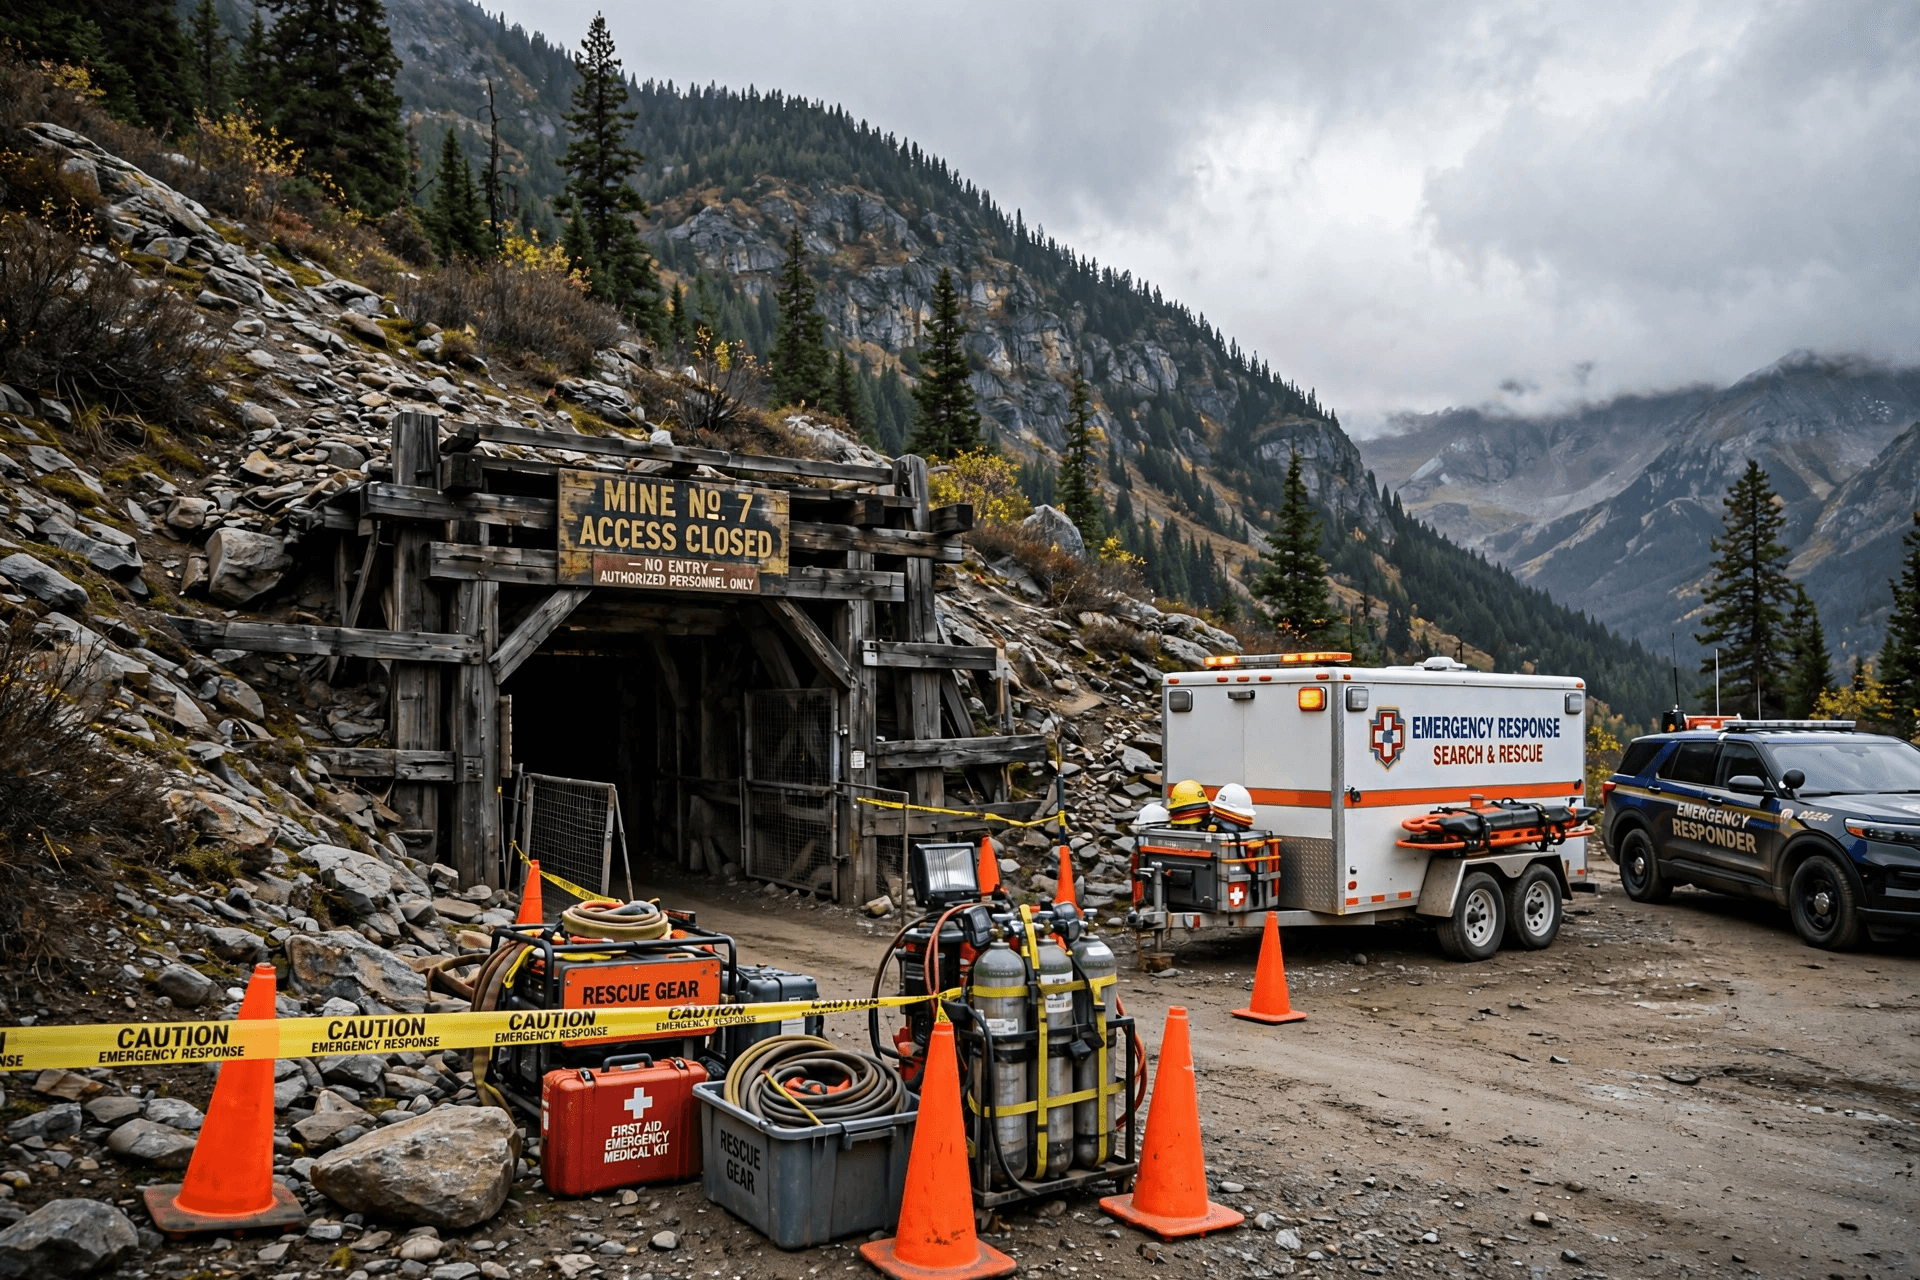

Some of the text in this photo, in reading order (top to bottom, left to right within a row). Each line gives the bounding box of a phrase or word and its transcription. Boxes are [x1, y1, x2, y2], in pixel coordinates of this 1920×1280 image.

[604, 479, 676, 518] MINE
[737, 492, 753, 523] 7
[579, 515, 772, 558] ACCESS CLOSED
[644, 558, 708, 574] NO ENTRY
[600, 570, 754, 591] AUTHORIZED PERSONNEL ONLY
[1412, 716, 1560, 739] EMERGENCY RESPONSE
[1433, 744, 1543, 766] SEARCH & RESCUE
[1676, 801, 1750, 829] EMERGENCY
[1671, 818, 1757, 854] RESPONDER
[582, 980, 699, 1005] RESCUE GEAR
[508, 1010, 596, 1031] CAUTION
[656, 1015, 757, 1031] EMERGENCY RESPONSE
[668, 1005, 745, 1020] CAUTION
[117, 1025, 229, 1049] CAUTION
[328, 1017, 426, 1040] CAUTION
[495, 1026, 608, 1043] EMERGENCY RESPONSE
[98, 1045, 245, 1063] EMERGENCY RESPONSE
[311, 1036, 440, 1053] EMERGENCY RESPONSE
[611, 1120, 662, 1138] FIRST AID
[605, 1130, 670, 1151] EMERGENCY
[720, 1129, 761, 1171] RESCUE
[604, 1142, 670, 1164] MEDICAL KIT
[727, 1159, 755, 1195] GEAR
